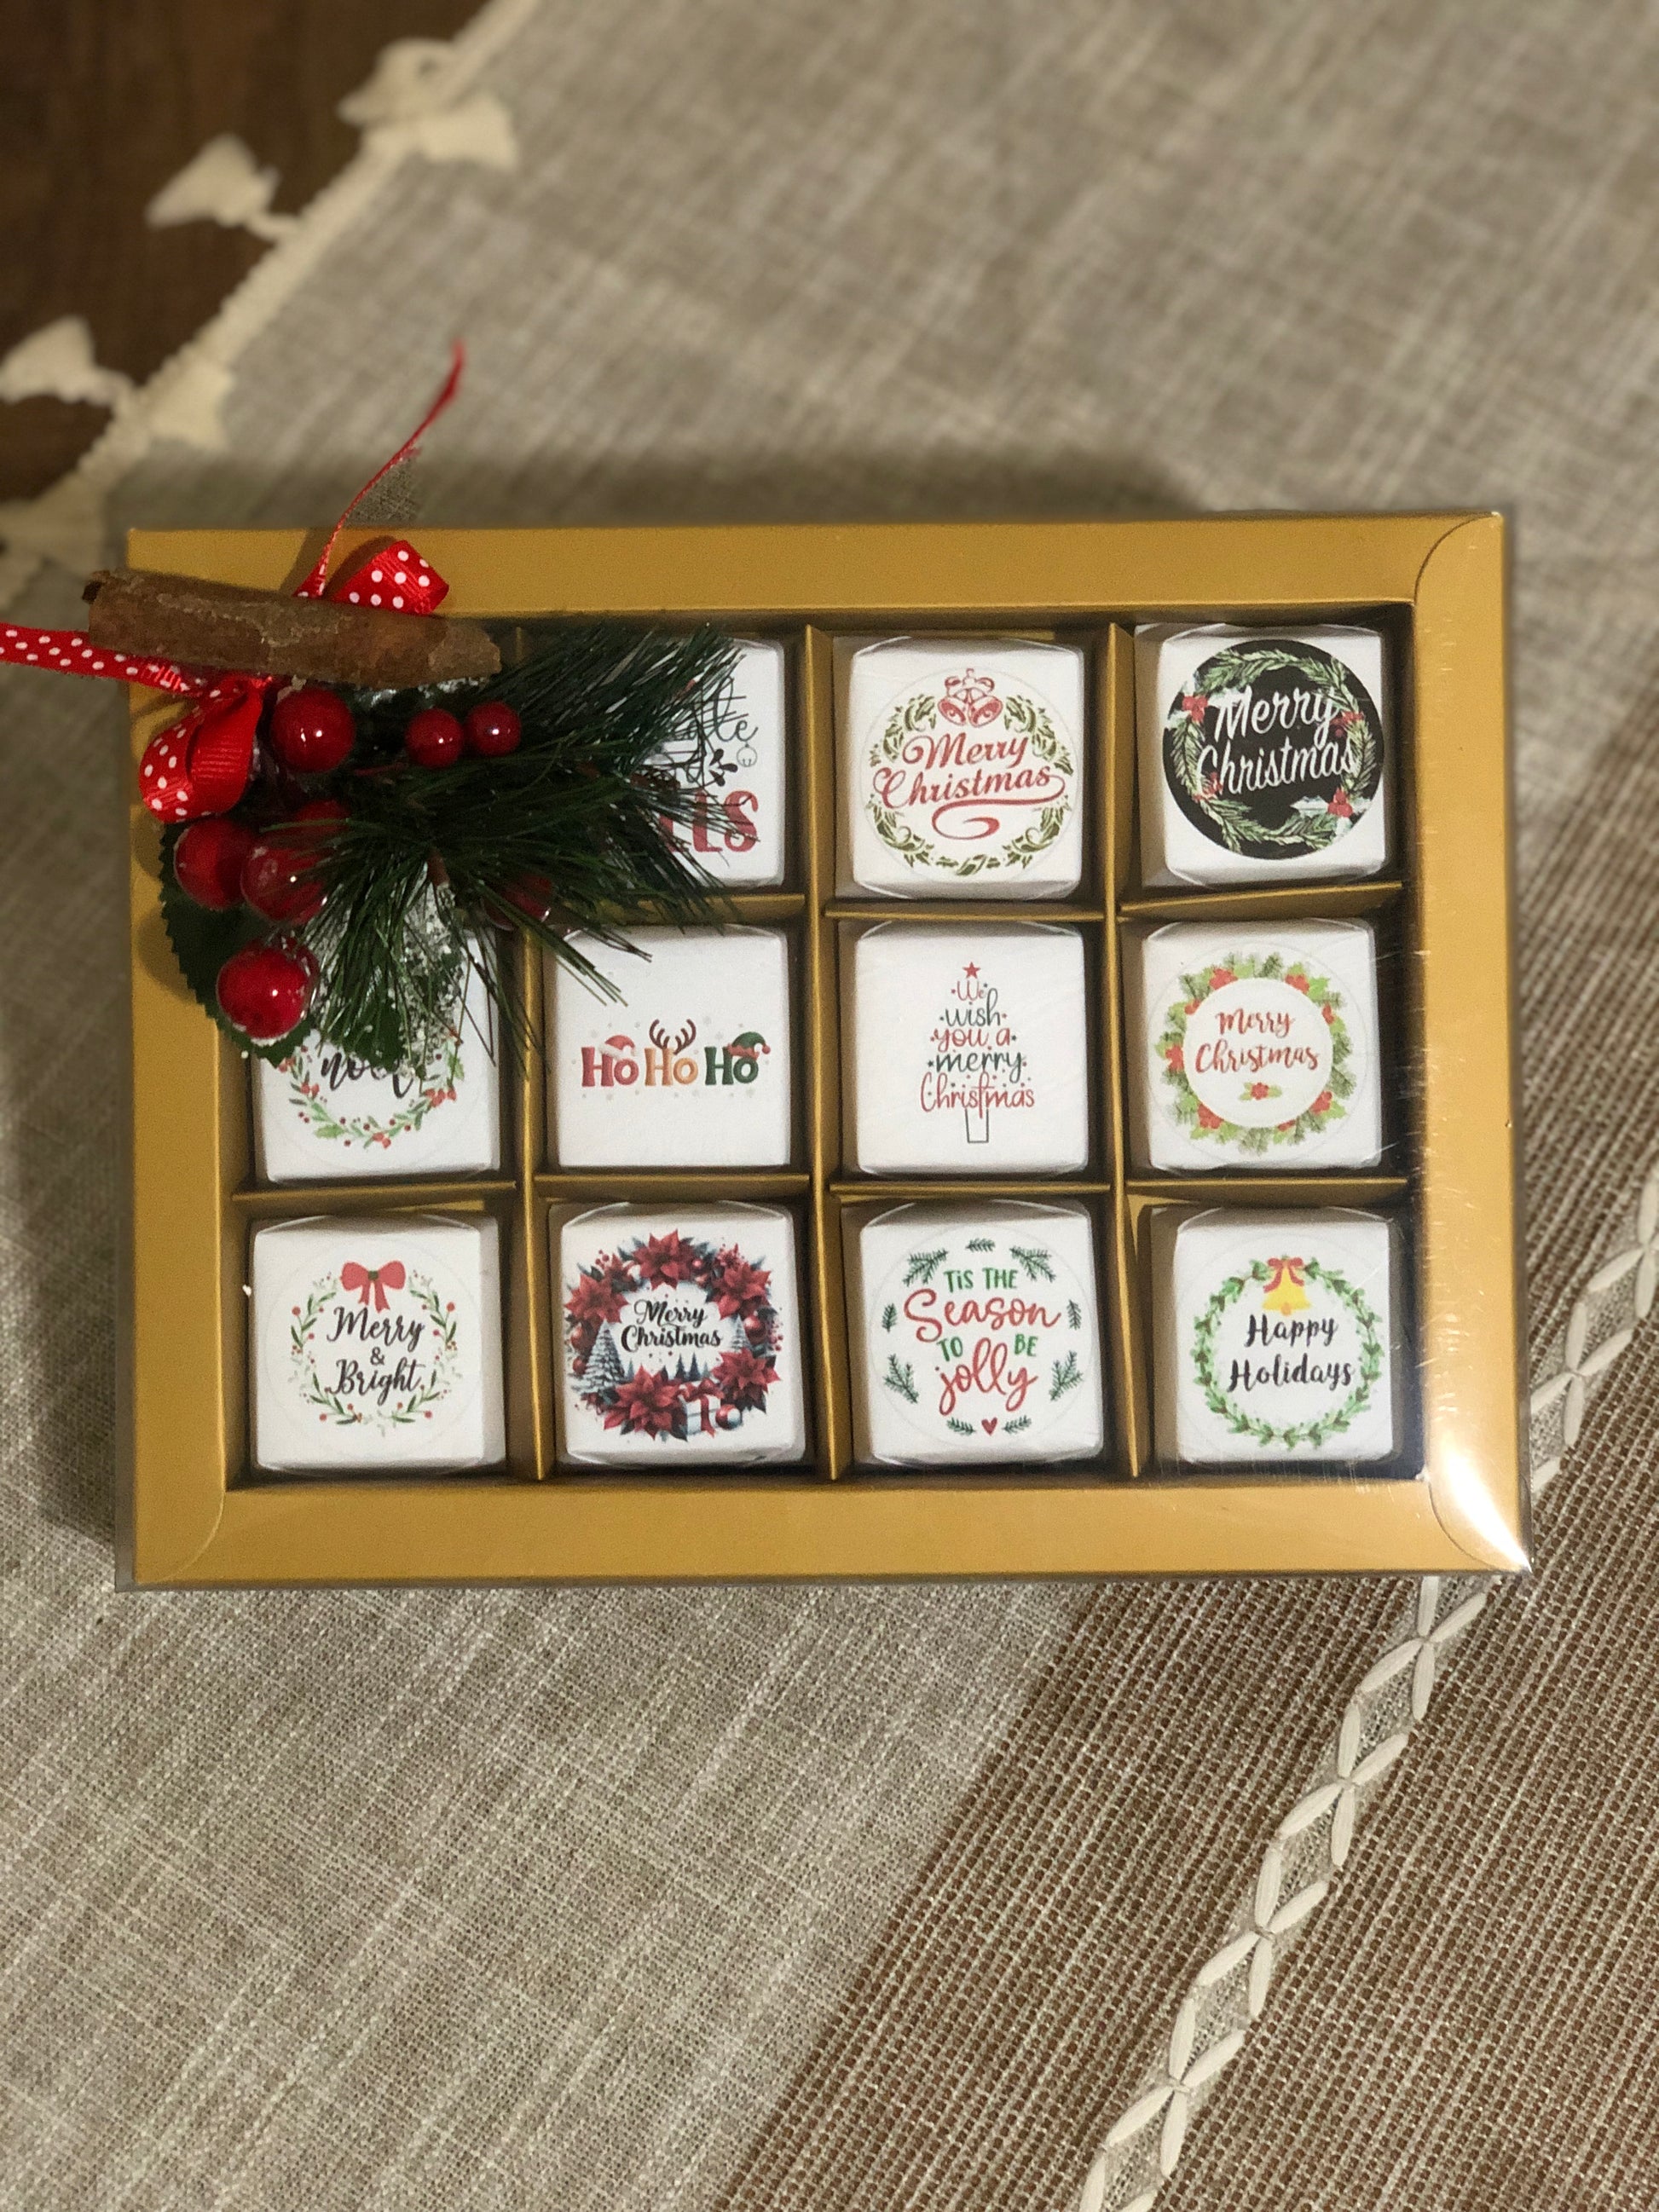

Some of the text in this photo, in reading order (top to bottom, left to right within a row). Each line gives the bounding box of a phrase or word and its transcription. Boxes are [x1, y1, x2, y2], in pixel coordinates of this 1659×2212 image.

[1212, 685, 1341, 750] Merry
[902, 732, 1029, 770] Merry
[1196, 736, 1356, 795] Christmas
[873, 765, 1066, 820] Christmas
[945, 988, 1002, 1026] wish
[1215, 1008, 1295, 1037] Merry
[933, 1027, 1011, 1053] you a
[1195, 1038, 1320, 1073] Christmas
[935, 1052, 1023, 1083] merry
[920, 1071, 1035, 1119] Christmas
[982, 1268, 1019, 1290] THE
[326, 1306, 425, 1353] Merry
[633, 1298, 708, 1328] Merry
[904, 1288, 1061, 1343] Season
[1244, 1314, 1339, 1347] Happy
[369, 1347, 385, 1366] &
[621, 1323, 723, 1353] Christmas
[937, 1333, 1038, 1362] TO BE
[324, 1356, 426, 1406] Bright
[935, 1337, 1038, 1416] jolly
[1227, 1353, 1356, 1393] Holidays
